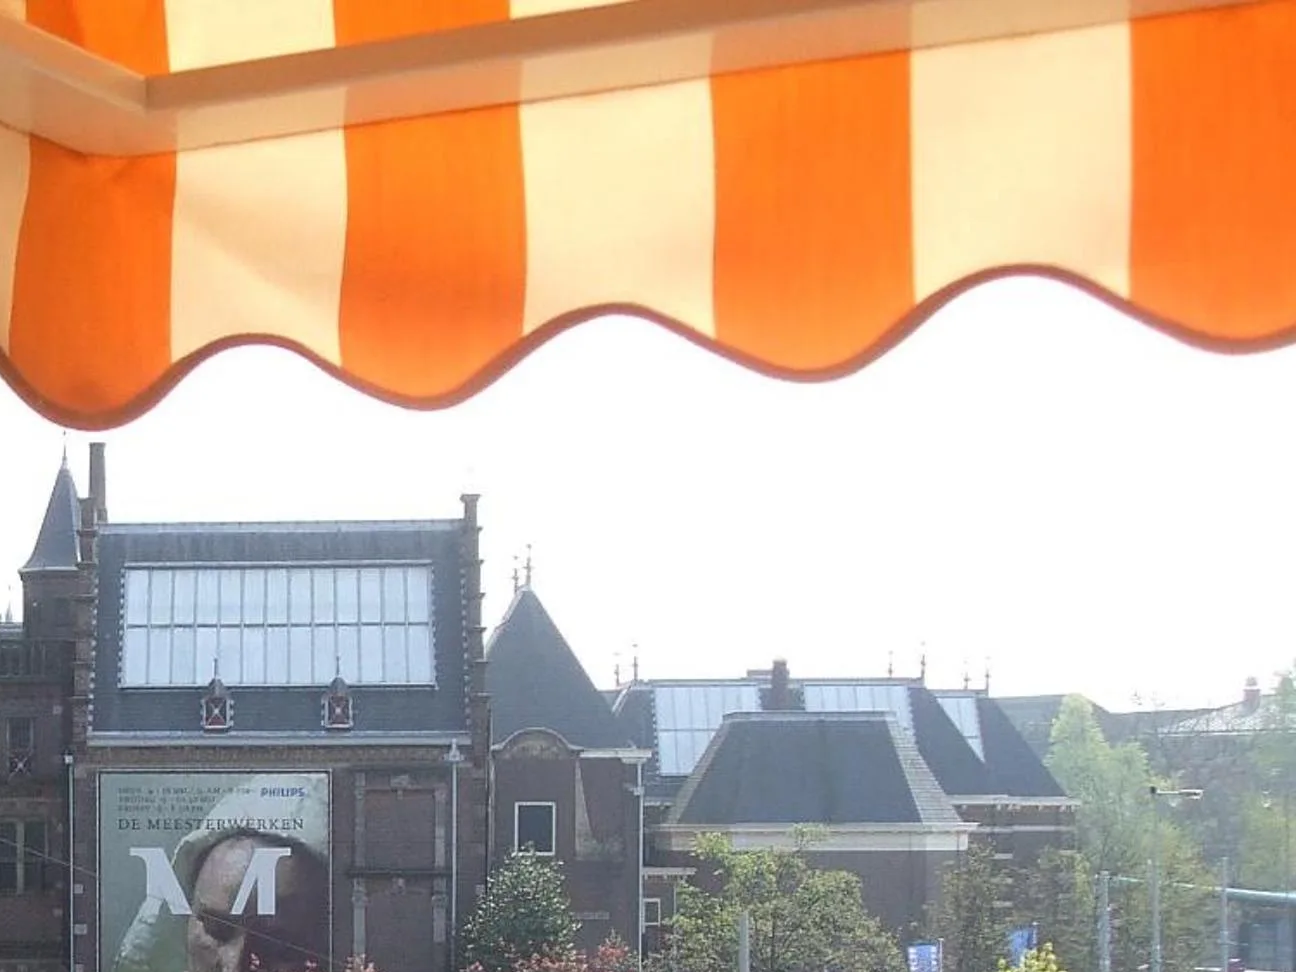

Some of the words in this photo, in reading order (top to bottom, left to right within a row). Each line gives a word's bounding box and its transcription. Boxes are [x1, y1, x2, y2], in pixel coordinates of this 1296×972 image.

[260, 787, 306, 798] PHILIPS
[117, 818, 141, 831] DE
[147, 818, 304, 831] MEESTERWERKEN
